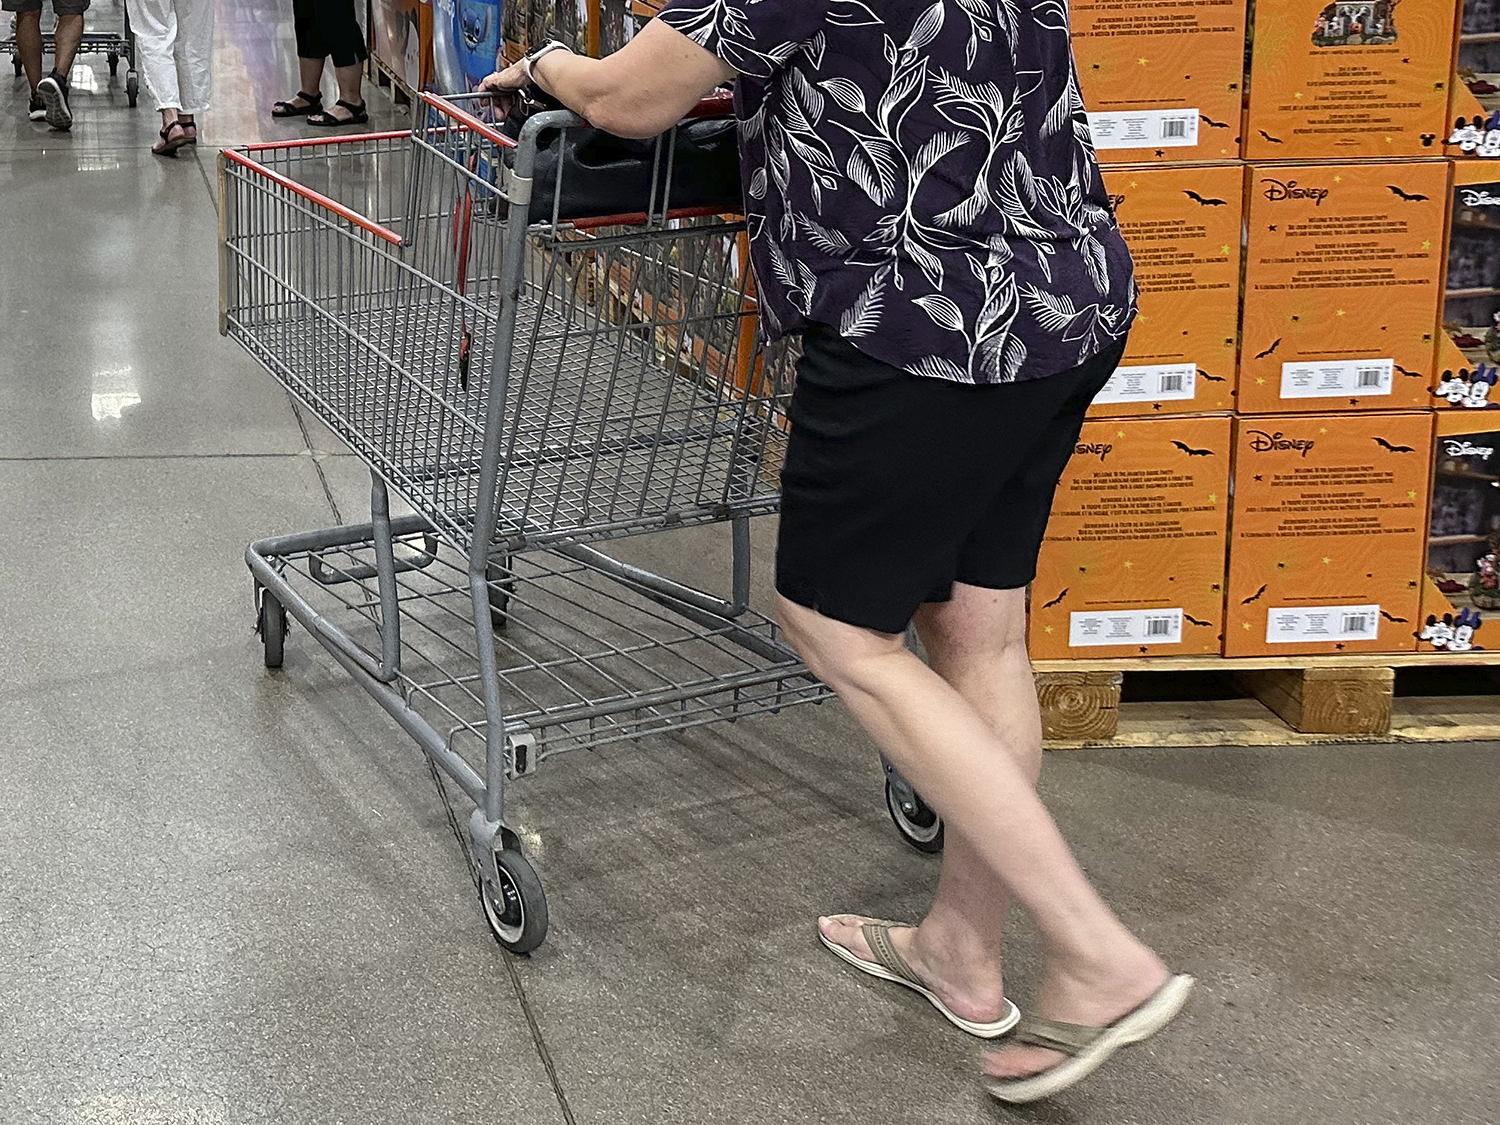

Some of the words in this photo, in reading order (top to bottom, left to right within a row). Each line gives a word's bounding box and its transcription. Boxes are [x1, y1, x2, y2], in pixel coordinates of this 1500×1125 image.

[1260, 179, 1329, 205] Disney
[1246, 430, 1314, 457] Disney
[1443, 440, 1494, 460] Disney
